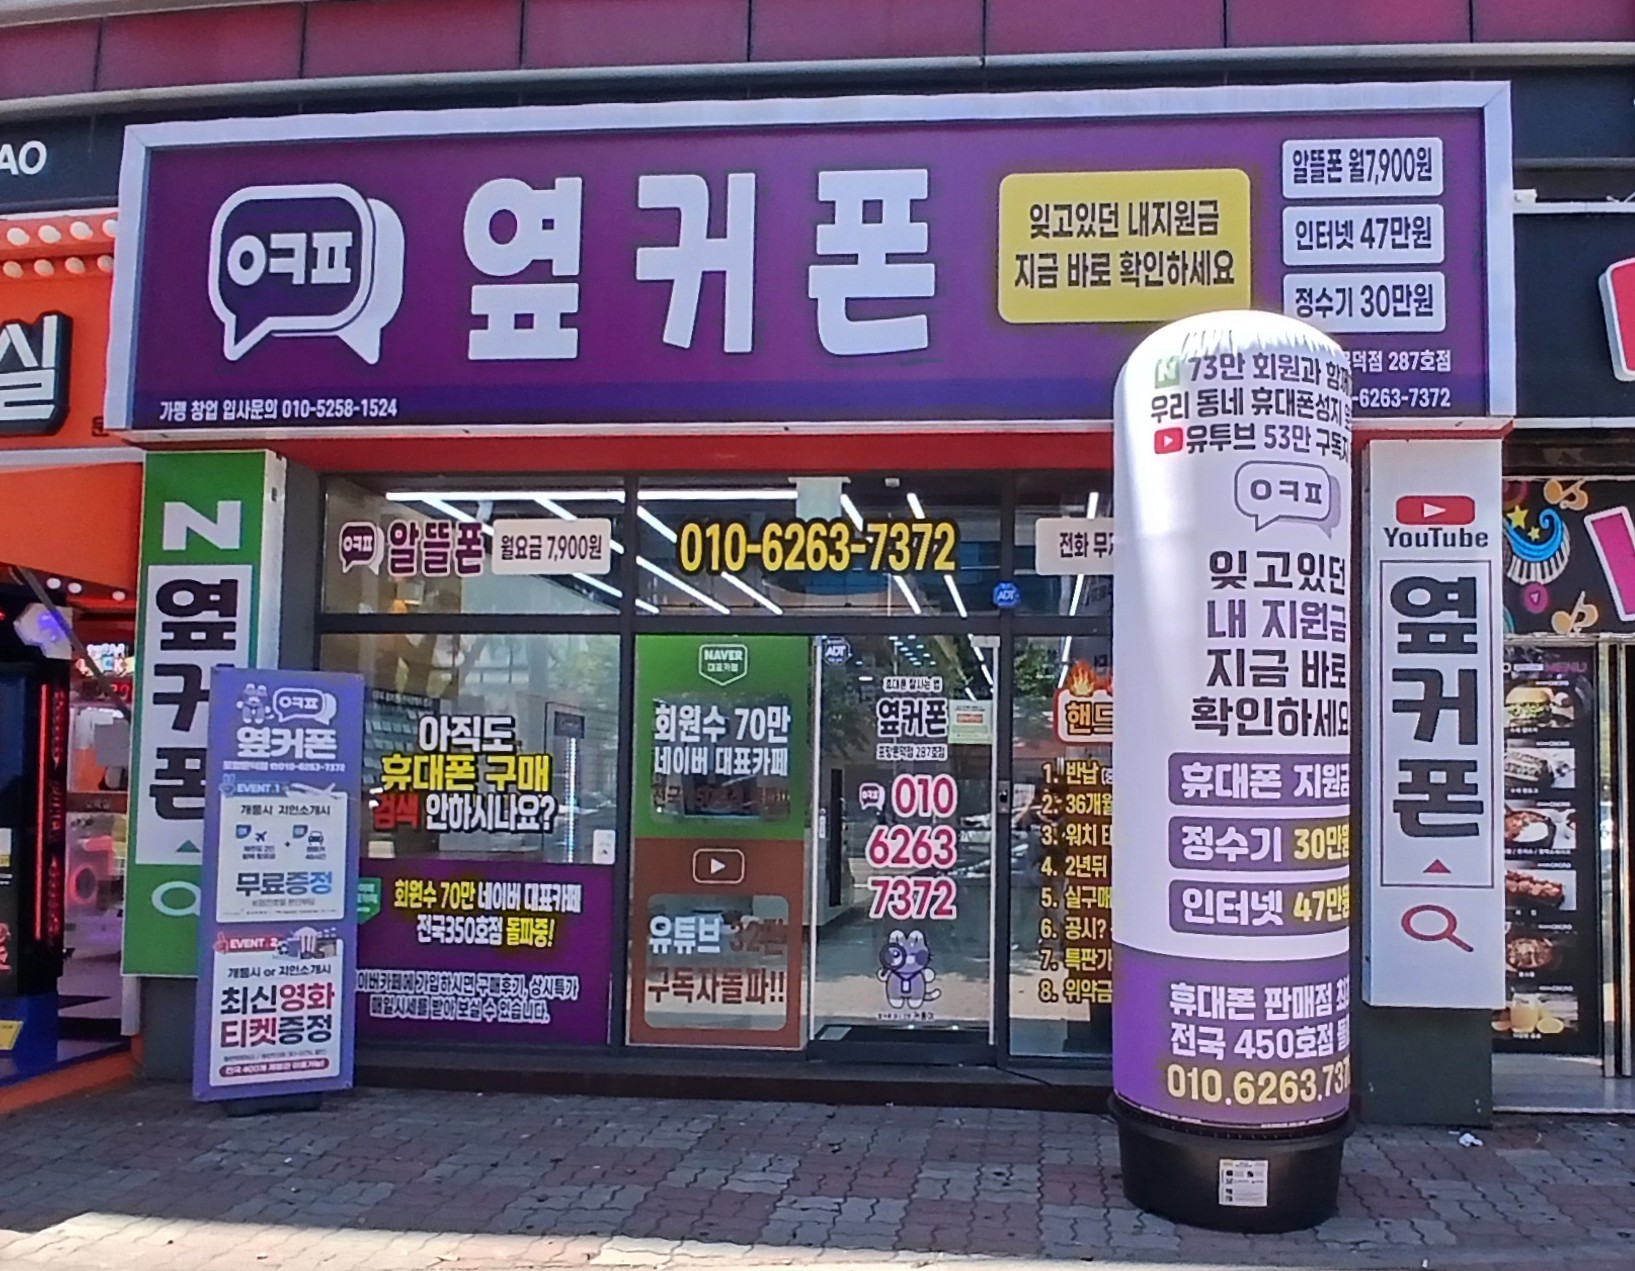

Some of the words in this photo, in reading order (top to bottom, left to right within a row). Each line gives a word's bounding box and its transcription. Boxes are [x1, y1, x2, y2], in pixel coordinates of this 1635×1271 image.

[1292, 149, 1342, 184] 알뜰폰
[1348, 147, 1432, 184] 월7,900원
[1029, 203, 1119, 239] 잊고있던
[1128, 200, 1219, 237] 내지원금
[1295, 218, 1354, 251] 인터넷
[1360, 216, 1432, 250] 47만원
[1015, 253, 1057, 289] 지금
[1067, 252, 1111, 287] 바로
[1119, 250, 1235, 286] 확인하세요
[1295, 286, 1352, 319] 정수기
[1360, 284, 1433, 317] 30만원
[1188, 354, 1245, 381] 73만
[1252, 353, 1321, 386] 회원과
[1388, 350, 1451, 372] 287호점
[159, 401, 187, 421] 가맹
[191, 401, 218, 420] 창업
[223, 400, 278, 420] 입사문의
[282, 399, 397, 419] 010-5258-1524
[1151, 392, 1189, 423] 우리
[1197, 388, 1243, 418] 동네
[1251, 386, 1342, 426] 휴대폰성지
[1186, 423, 1256, 454] 유투브
[1263, 425, 1311, 453] 53만
[388, 520, 483, 577] 알뜰폰
[501, 534, 542, 561] 월요금
[547, 533, 602, 562] 7,900원
[680, 521, 956, 573] 010-6263-7372
[1060, 531, 1089, 558] 전화
[1384, 526, 1488, 548] YouTube
[1209, 550, 1345, 595] 잊고있던
[996, 589, 1016, 601] ADT
[1207, 599, 1246, 638] 내
[1262, 600, 1346, 643] 지원금
[704, 650, 743, 661] NAVER
[825, 645, 847, 657] ADT
[1206, 649, 1289, 687] 지금
[1301, 650, 1346, 688] 바로
[654, 705, 726, 743] 회원수
[734, 705, 791, 743] 70만
[878, 699, 947, 735] 옆커폰
[1191, 696, 1349, 737] 확인하세요
[1391, 575, 1483, 838] 옆커폰
[236, 727, 337, 760] 옆커폰
[418, 715, 516, 752] 아직도
[381, 753, 478, 791] 휴대폰
[486, 754, 550, 792] 구매
[654, 746, 708, 775] 네이버
[715, 747, 788, 776] 대표카페
[1043, 764, 1058, 784] 1.
[1066, 761, 1099, 785] 반납
[894, 777, 955, 815] 010
[1181, 762, 1282, 799] 휴대폰
[373, 793, 419, 829] 검색
[426, 794, 556, 832] 안하시나요?
[1042, 794, 1058, 815] 2.
[1066, 793, 1113, 816] 36개월
[868, 828, 955, 866] 6263
[1042, 824, 1058, 846] 3.
[1066, 823, 1097, 846] 워치
[1181, 826, 1282, 863] 정수기
[236, 871, 332, 896] 무료증정
[1041, 857, 1057, 876] 4.
[1065, 856, 1106, 878] 2년뒤
[394, 879, 437, 909] 회원수
[440, 881, 476, 910] 70만
[478, 882, 521, 912] 네이버
[524, 883, 582, 913] 대표카페
[870, 879, 954, 917] 7372
[1041, 887, 1057, 907] 5.
[1183, 888, 1283, 926] 인터넷
[416, 914, 503, 946] 전국350호점
[506, 917, 556, 947] 돌파중!
[649, 916, 720, 954] 유튜브
[1040, 918, 1057, 939] 6.
[1065, 917, 1106, 940] 공시?
[263, 967, 276, 977] or
[1040, 948, 1057, 970] 7.
[220, 982, 335, 1015] 최신영화
[416, 971, 475, 996] 가입하시면
[476, 973, 529, 999] 구매후기,
[530, 975, 579, 1001] 상시특가
[648, 966, 784, 1005] 구독자돌파!!
[1039, 980, 1058, 1001] 8.
[1065, 979, 1112, 1003] 위약금
[1170, 982, 1256, 1020] 휴대폰
[1264, 982, 1332, 1020] 판매점
[430, 996, 456, 1020] 받아
[456, 997, 482, 1021] 보실
[483, 997, 496, 1021] 수
[498, 999, 550, 1024] 있습니다.
[220, 1014, 332, 1048] 티켓증정
[1171, 1022, 1226, 1060] 전국
[1234, 1023, 1333, 1060] 450호점
